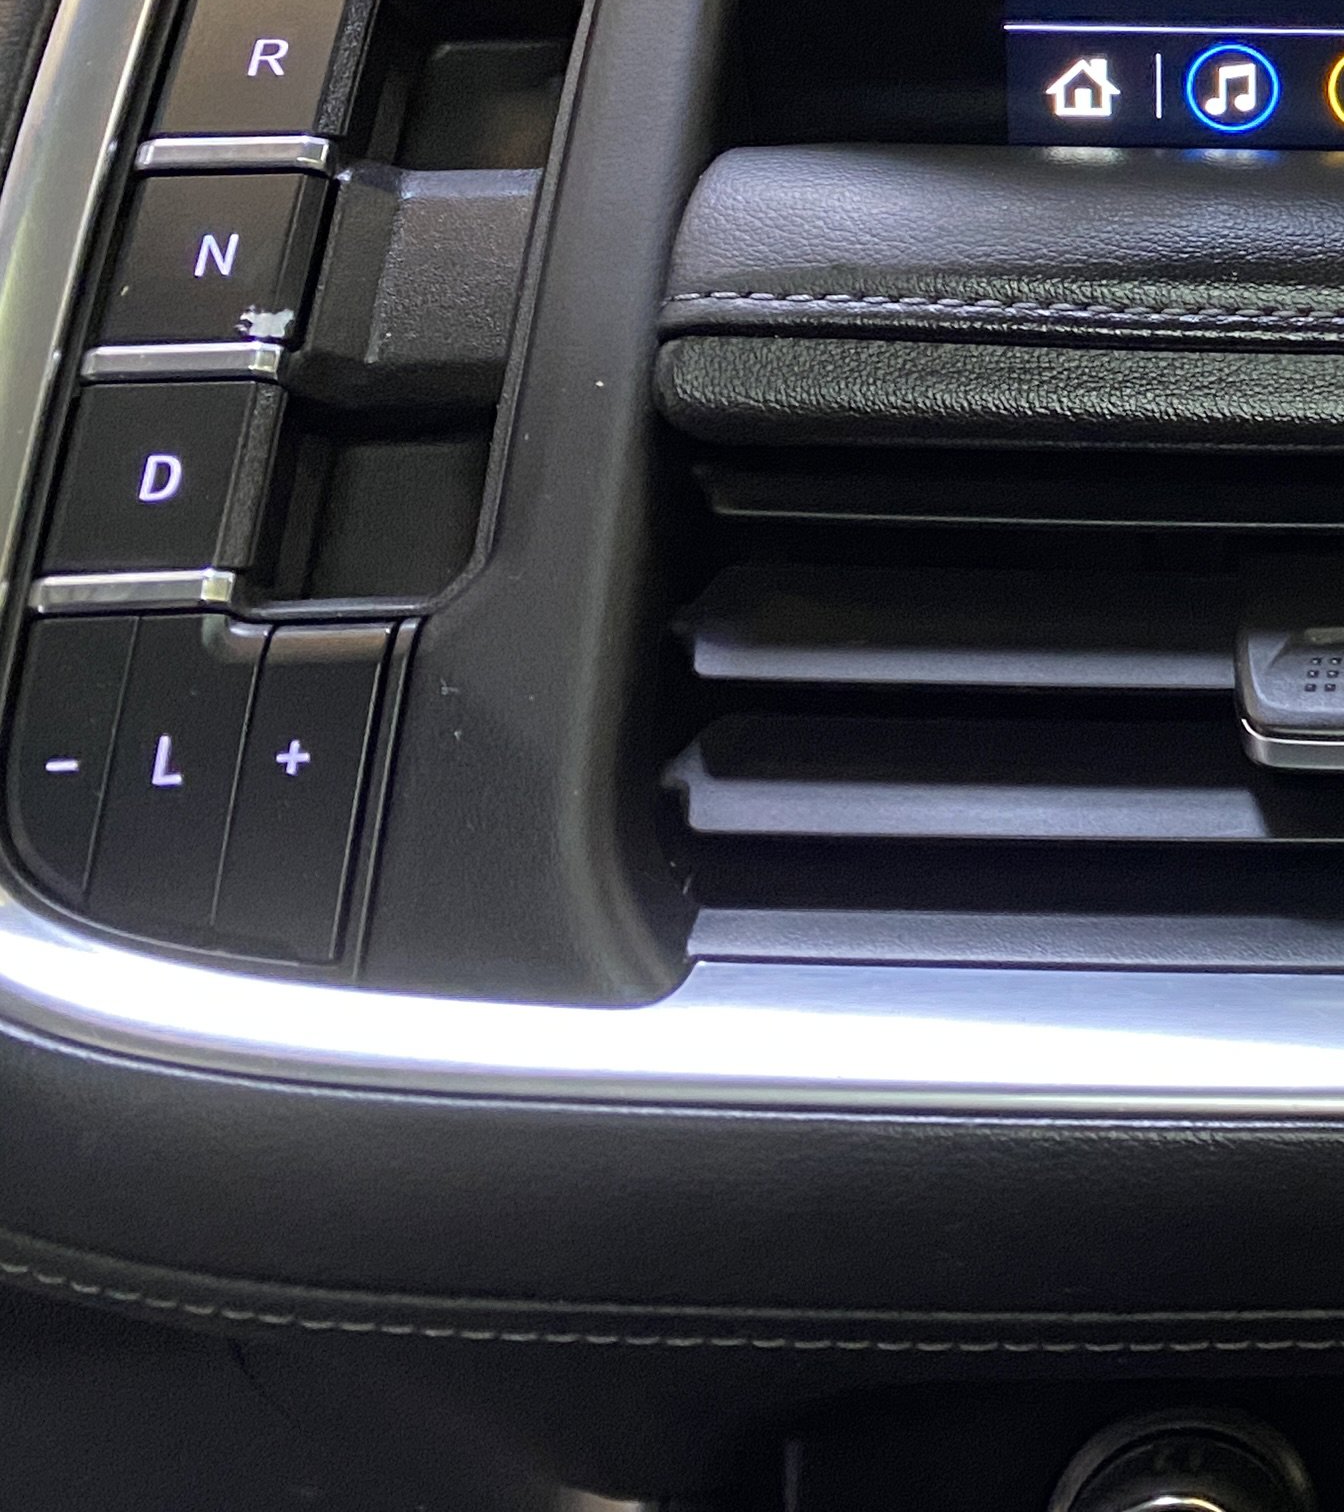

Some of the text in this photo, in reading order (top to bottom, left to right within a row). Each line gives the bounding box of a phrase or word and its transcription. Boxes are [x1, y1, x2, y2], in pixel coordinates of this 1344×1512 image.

[247, 38, 289, 77] R
[194, 233, 239, 276] N
[138, 454, 182, 503] D
[151, 734, 182, 786] L
